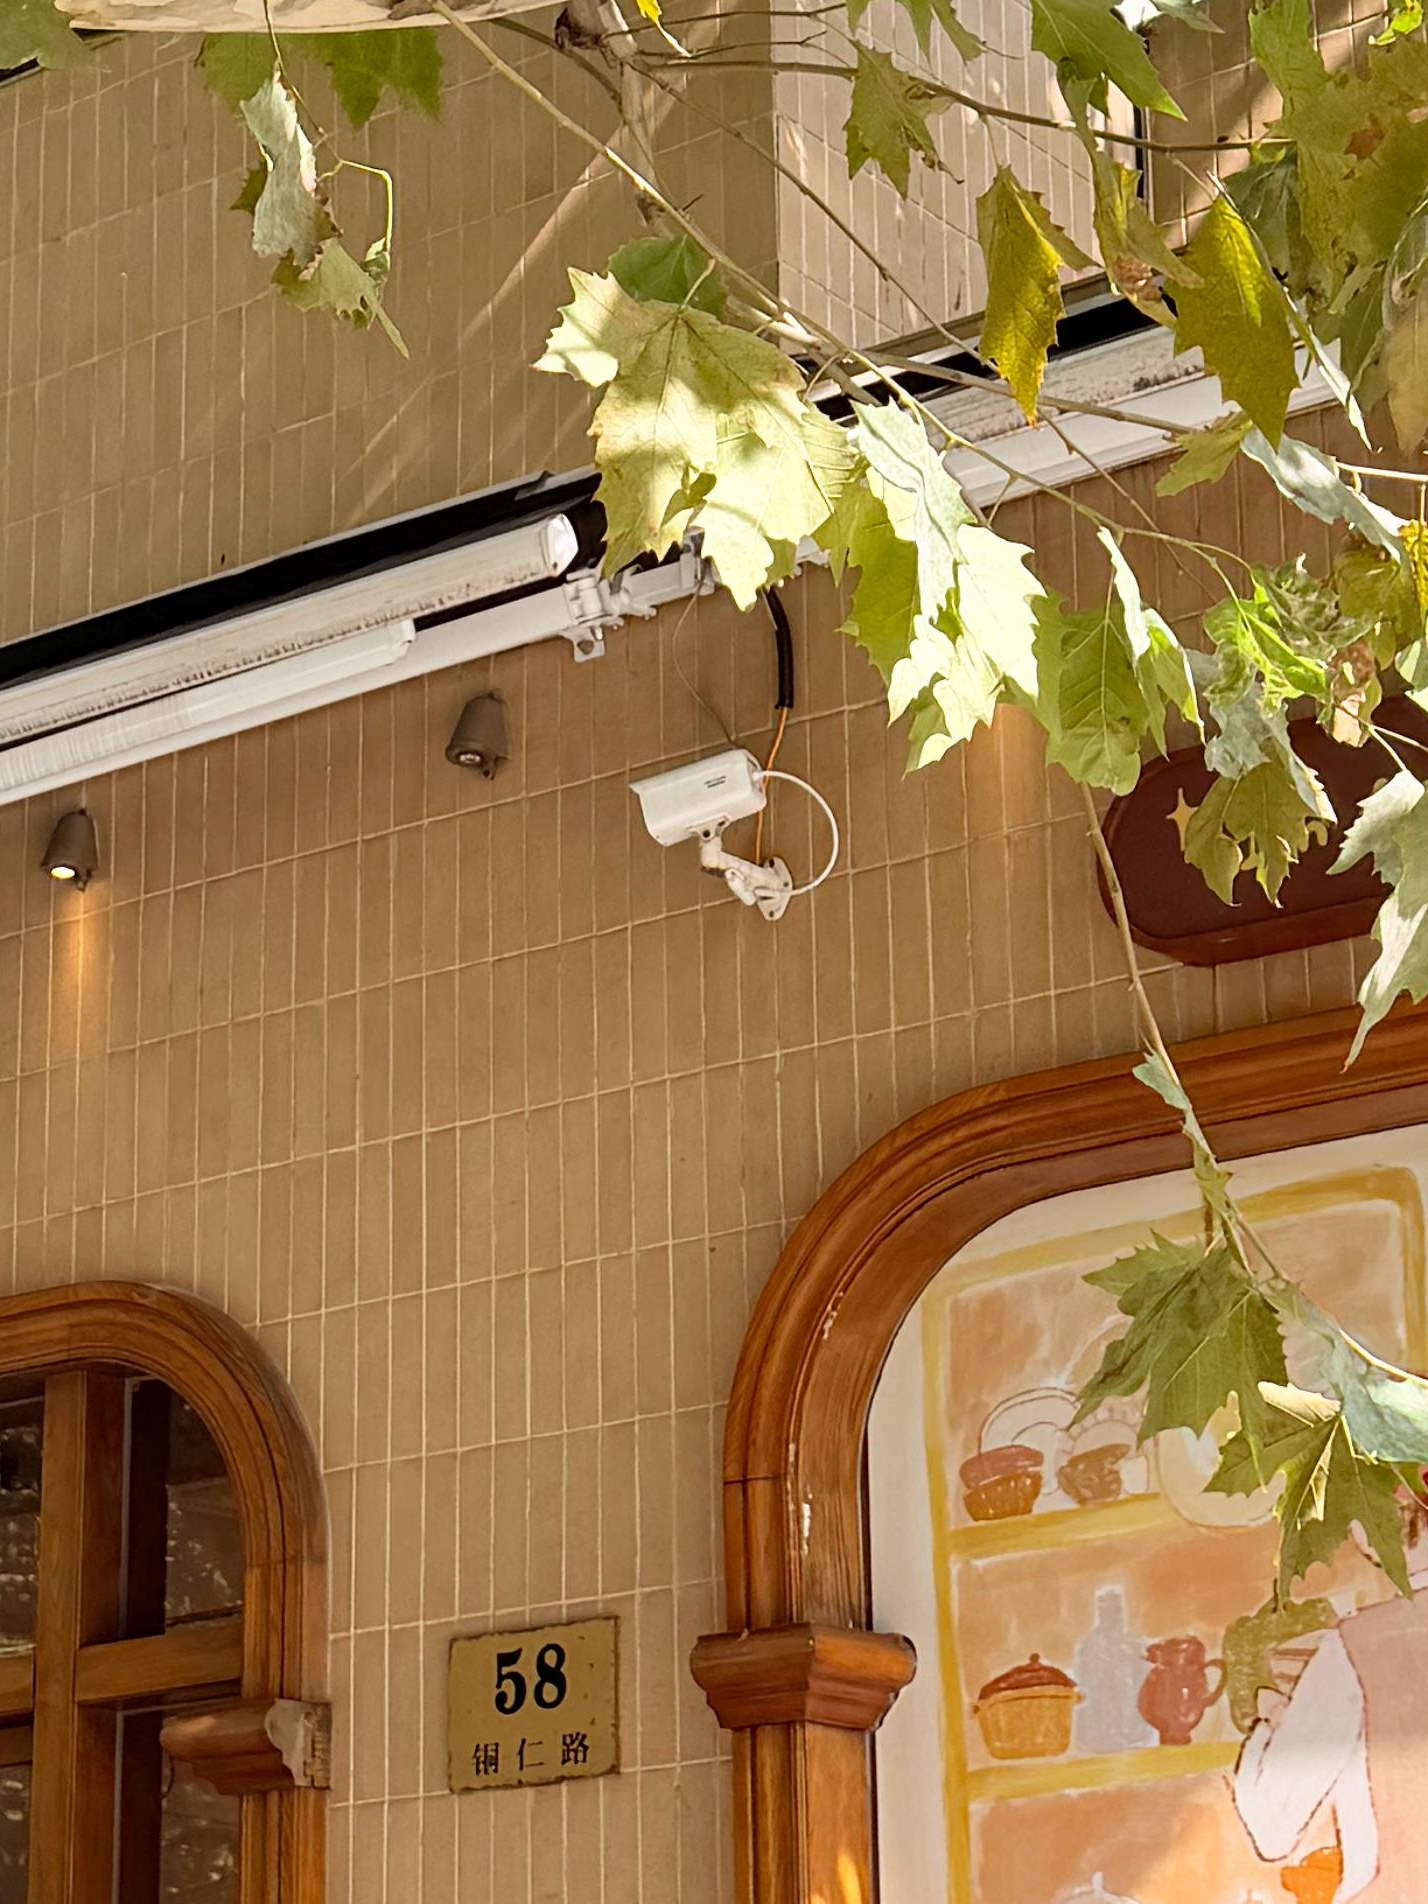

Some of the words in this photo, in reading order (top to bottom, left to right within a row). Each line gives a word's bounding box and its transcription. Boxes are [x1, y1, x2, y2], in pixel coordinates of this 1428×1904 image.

[494, 1643, 567, 1715] 58
[472, 1731, 589, 1776] 铜仁路
